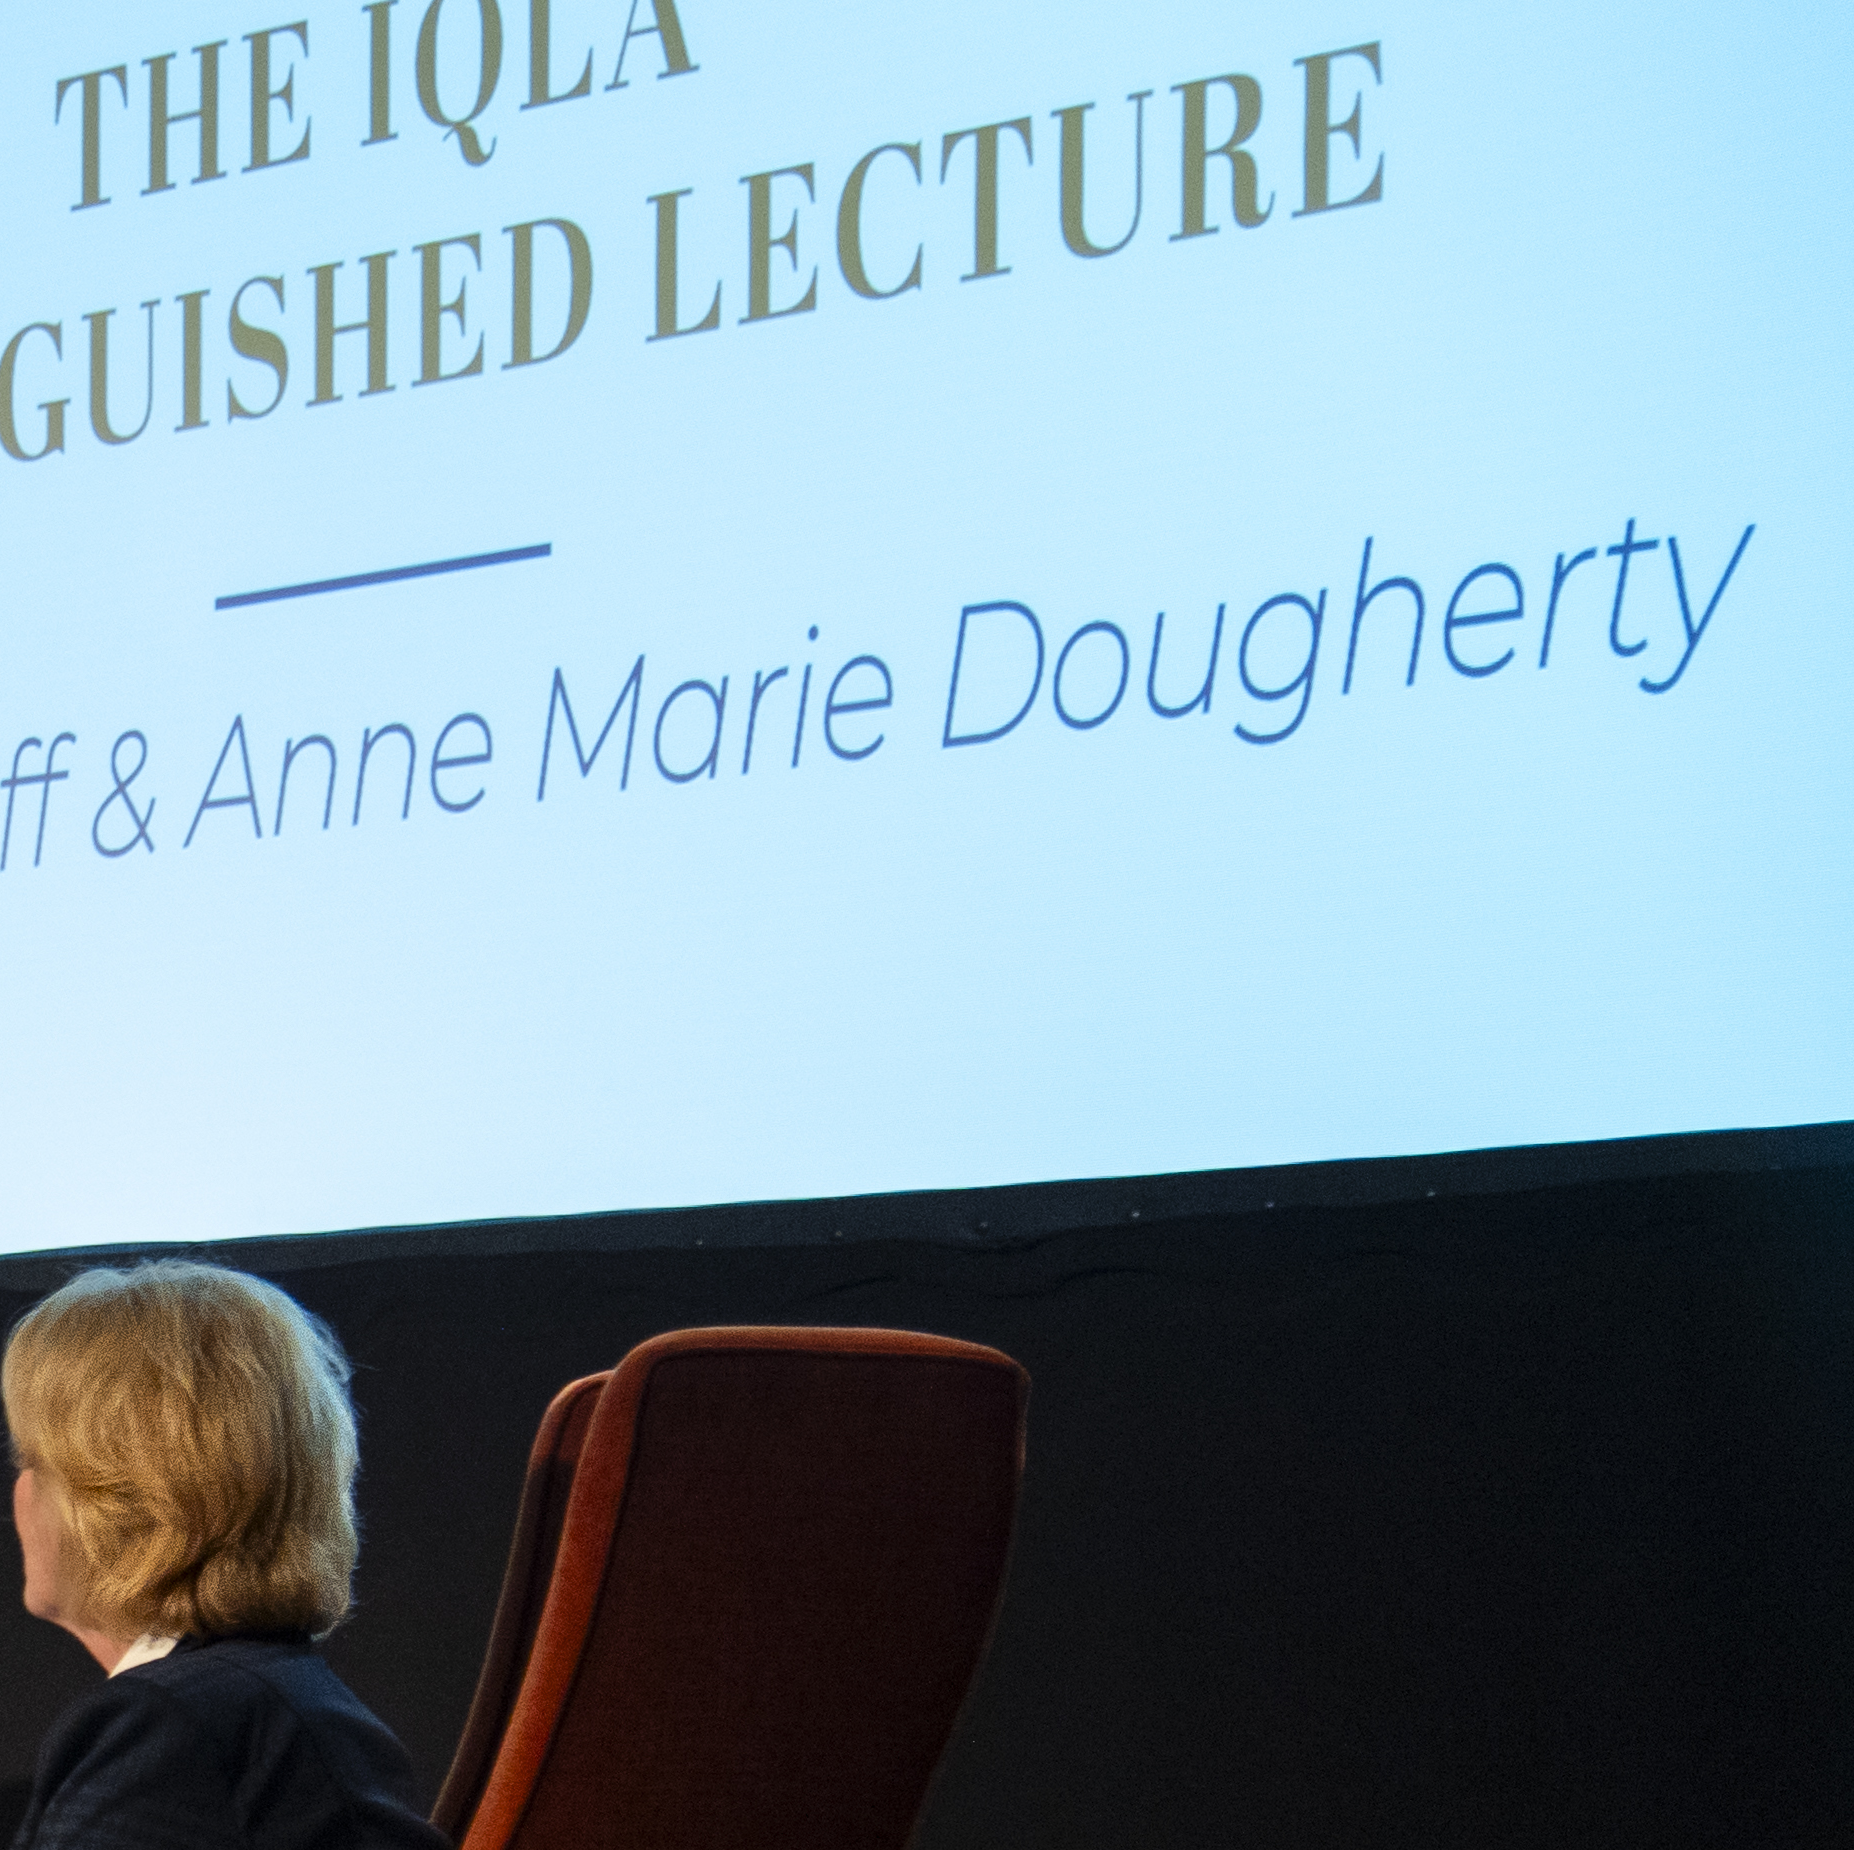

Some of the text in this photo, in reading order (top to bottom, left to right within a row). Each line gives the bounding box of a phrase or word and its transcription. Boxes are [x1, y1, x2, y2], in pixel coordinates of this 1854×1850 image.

[55, 0, 701, 213] THE IQLA
[644, 39, 1386, 344] LECTURE
[90, 728, 157, 859] &
[182, 711, 494, 850] Anne
[536, 623, 895, 803] Marie
[941, 516, 1758, 750] Dougherty
